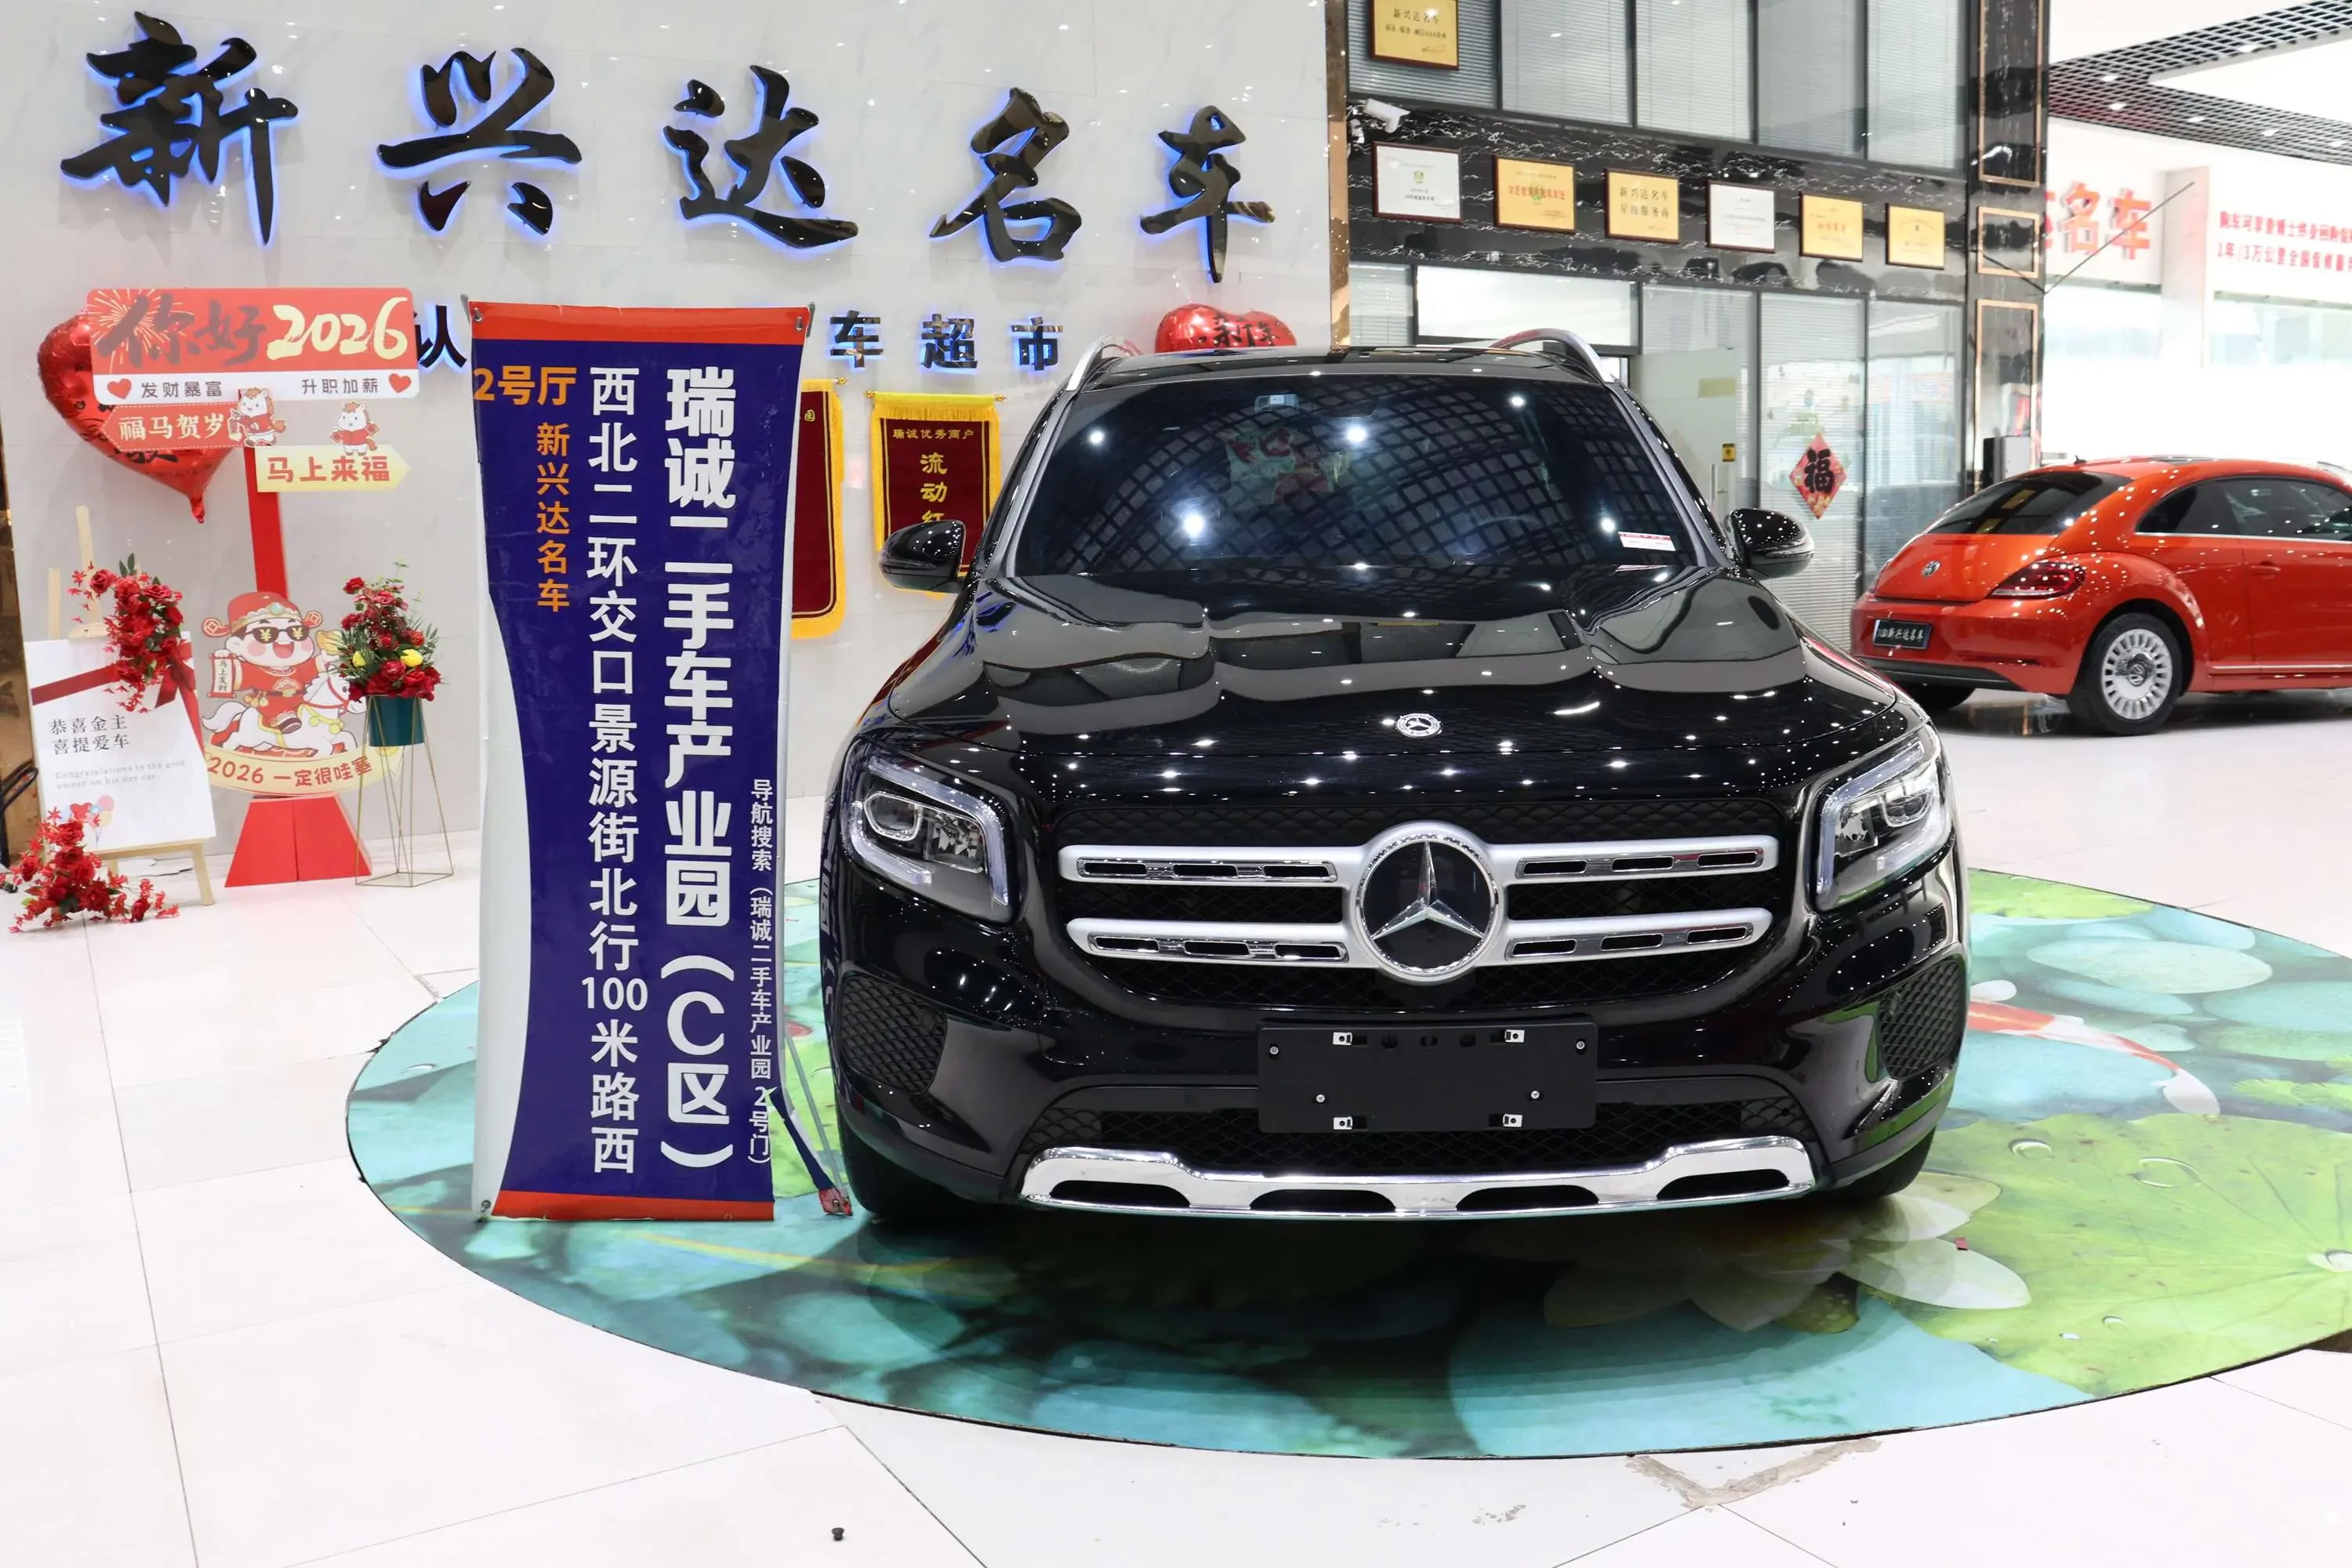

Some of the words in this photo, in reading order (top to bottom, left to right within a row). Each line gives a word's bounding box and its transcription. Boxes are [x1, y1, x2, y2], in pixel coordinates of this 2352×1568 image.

[2045, 181, 2151, 260] 名车
[94, 289, 267, 368] 你好
[266, 296, 409, 361] 2026
[140, 380, 223, 399] 发财暴富
[301, 377, 379, 395] 升职加薪
[473, 365, 577, 406] 2号厅
[118, 412, 224, 441] 福马贺岁
[892, 429, 975, 440] 瑞诚优秀商户
[267, 455, 390, 484] 马上来福
[1804, 448, 1835, 494] 福
[536, 422, 571, 613] 新兴达名车
[49, 713, 129, 735] 恭喜金主
[51, 733, 130, 756] 喜提爱车
[55, 766, 132, 781] Congratulations
[147, 762, 162, 771] the
[207, 757, 264, 784] 2026
[581, 366, 648, 1174] 西北二环交口景源街北行100米路西
